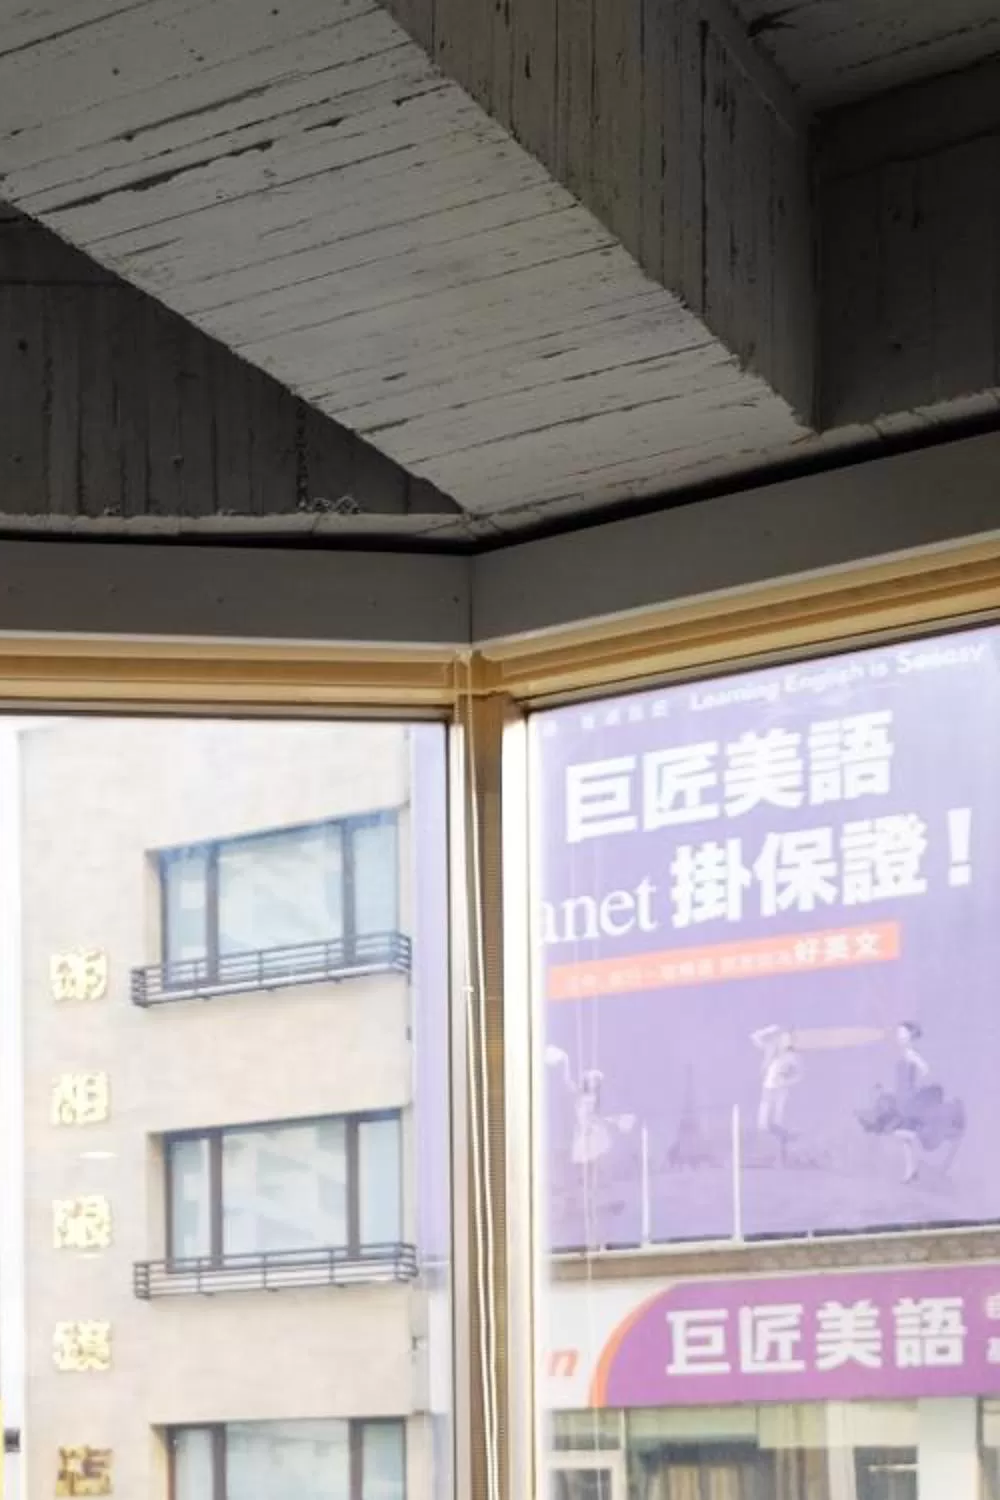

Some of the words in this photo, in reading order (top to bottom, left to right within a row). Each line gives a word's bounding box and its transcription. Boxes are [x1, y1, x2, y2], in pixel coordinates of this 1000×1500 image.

[566, 710, 894, 844] 巨匠美語
[666, 1296, 968, 1377] 巨匠美語
